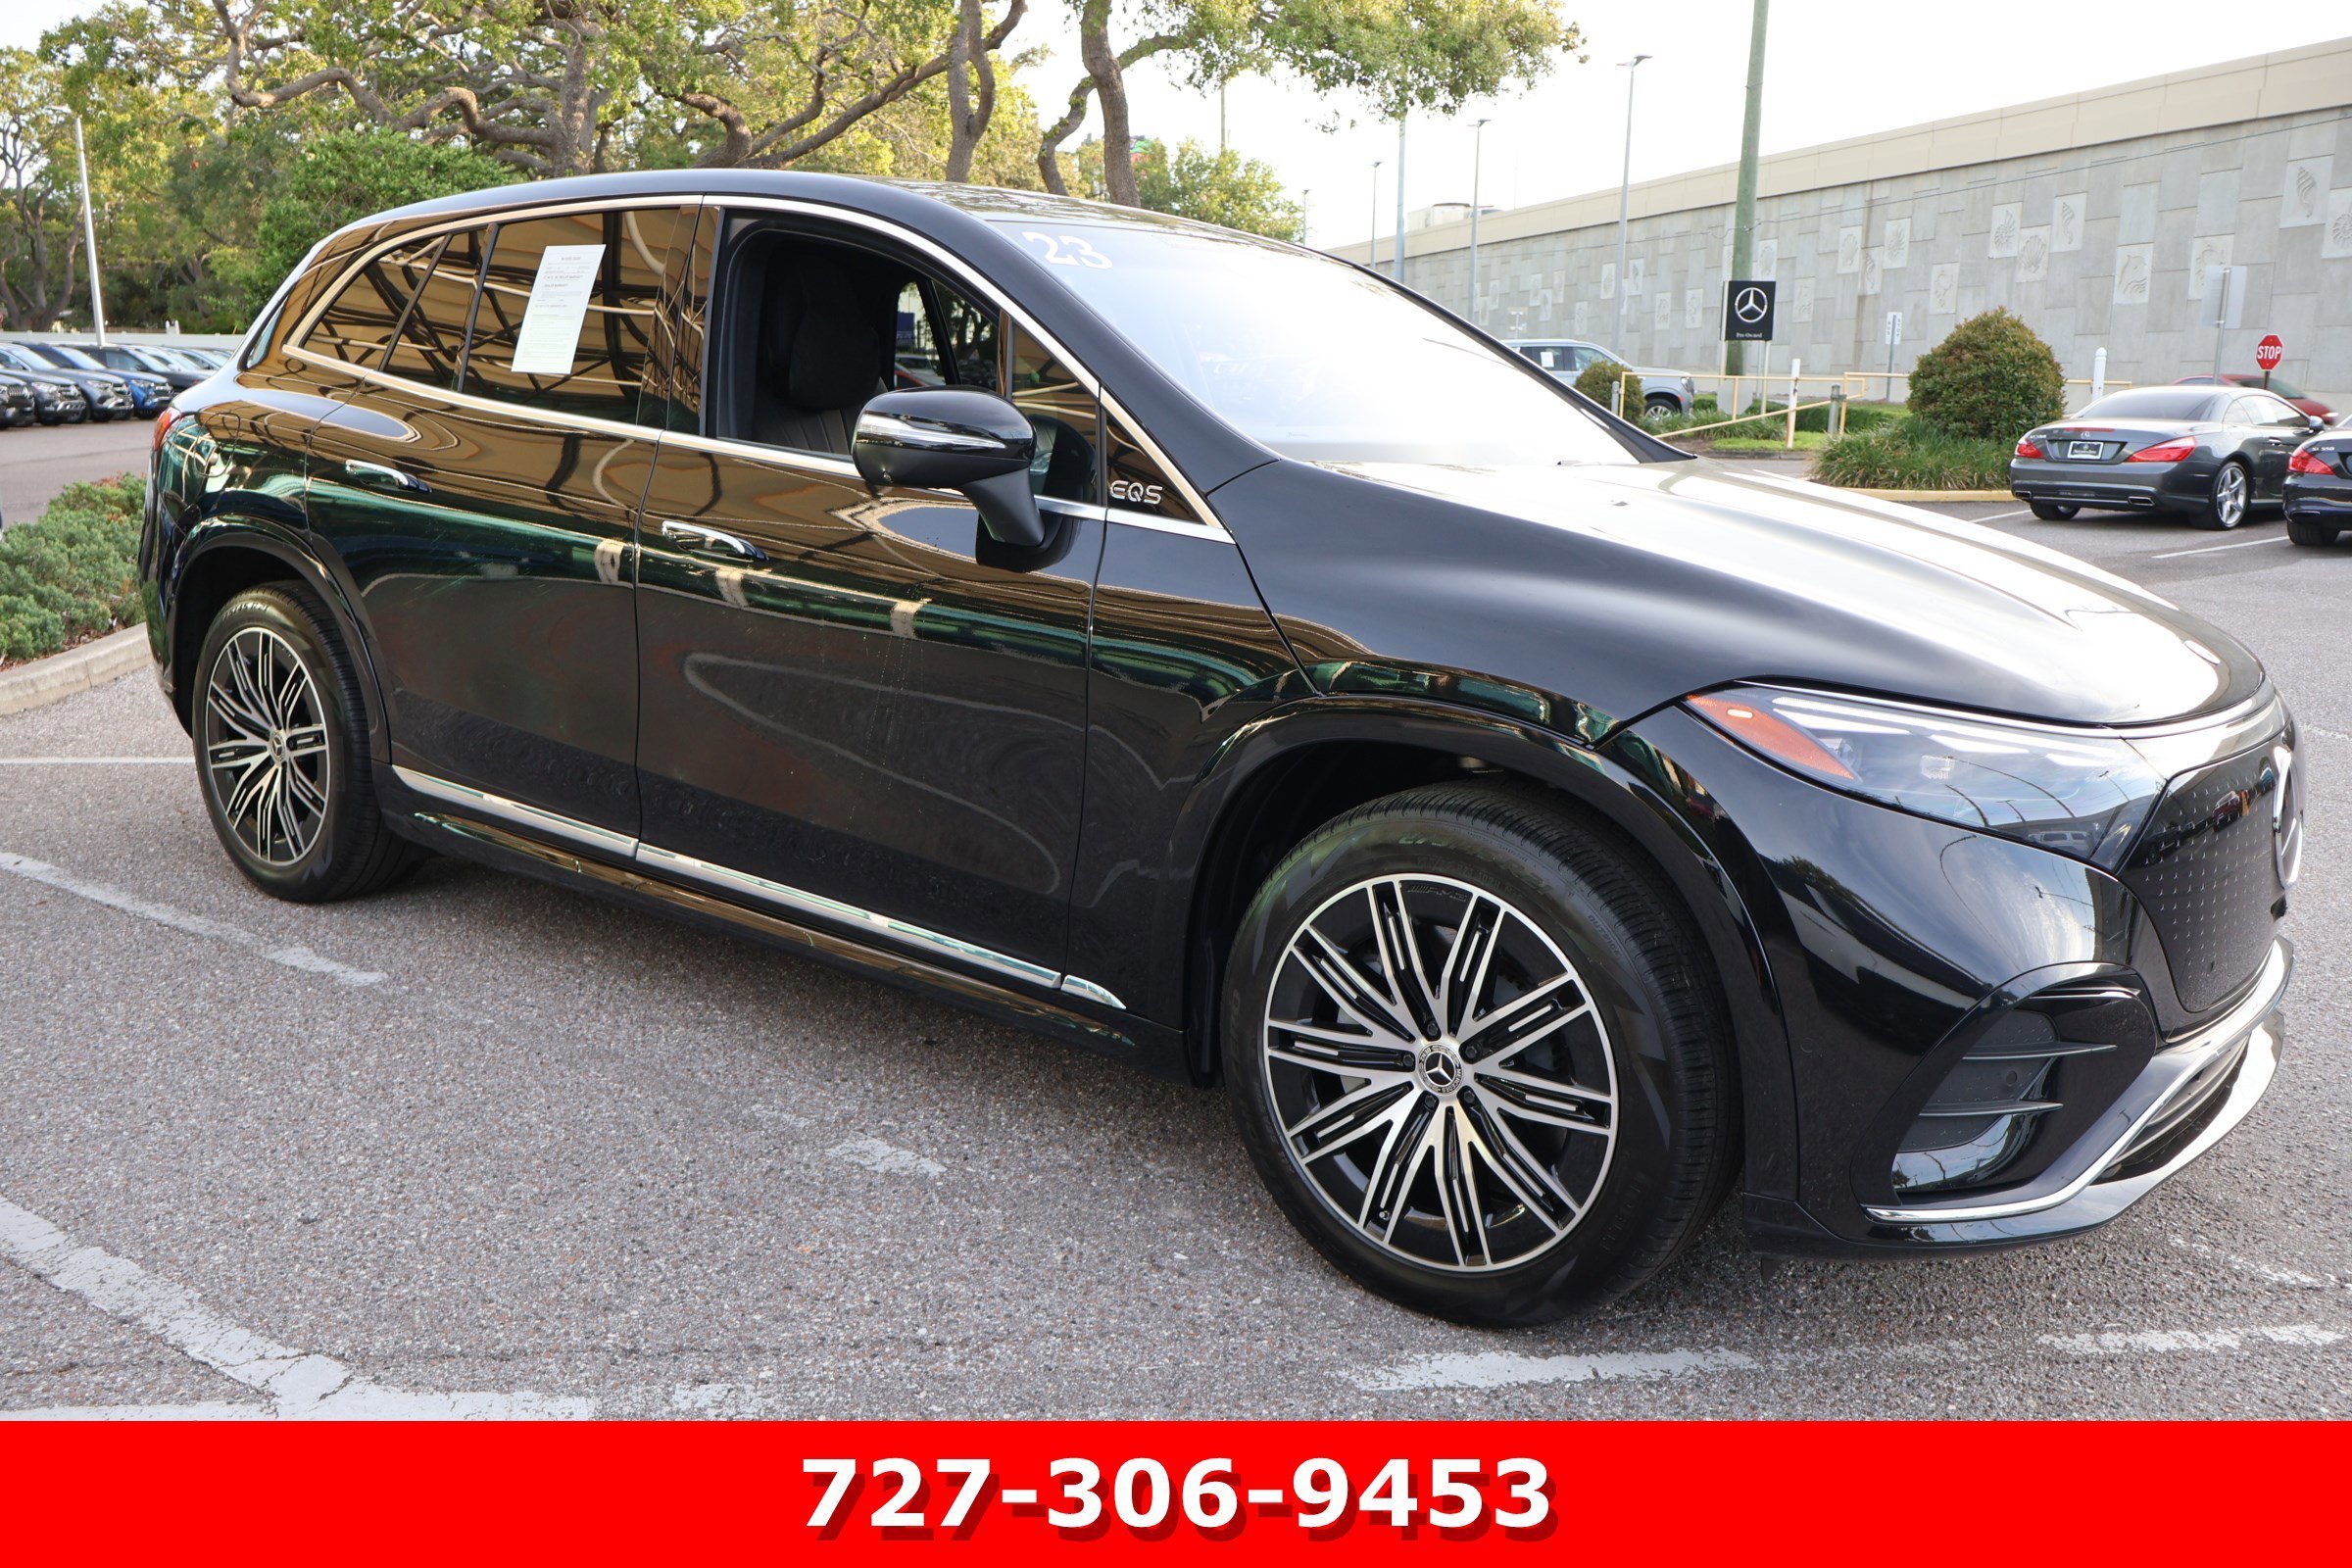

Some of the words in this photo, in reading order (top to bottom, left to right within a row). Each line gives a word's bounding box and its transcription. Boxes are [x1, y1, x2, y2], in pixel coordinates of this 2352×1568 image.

[1020, 230, 1113, 270] 23
[2257, 345, 2282, 360] STOP
[1109, 479, 1163, 505] EQS
